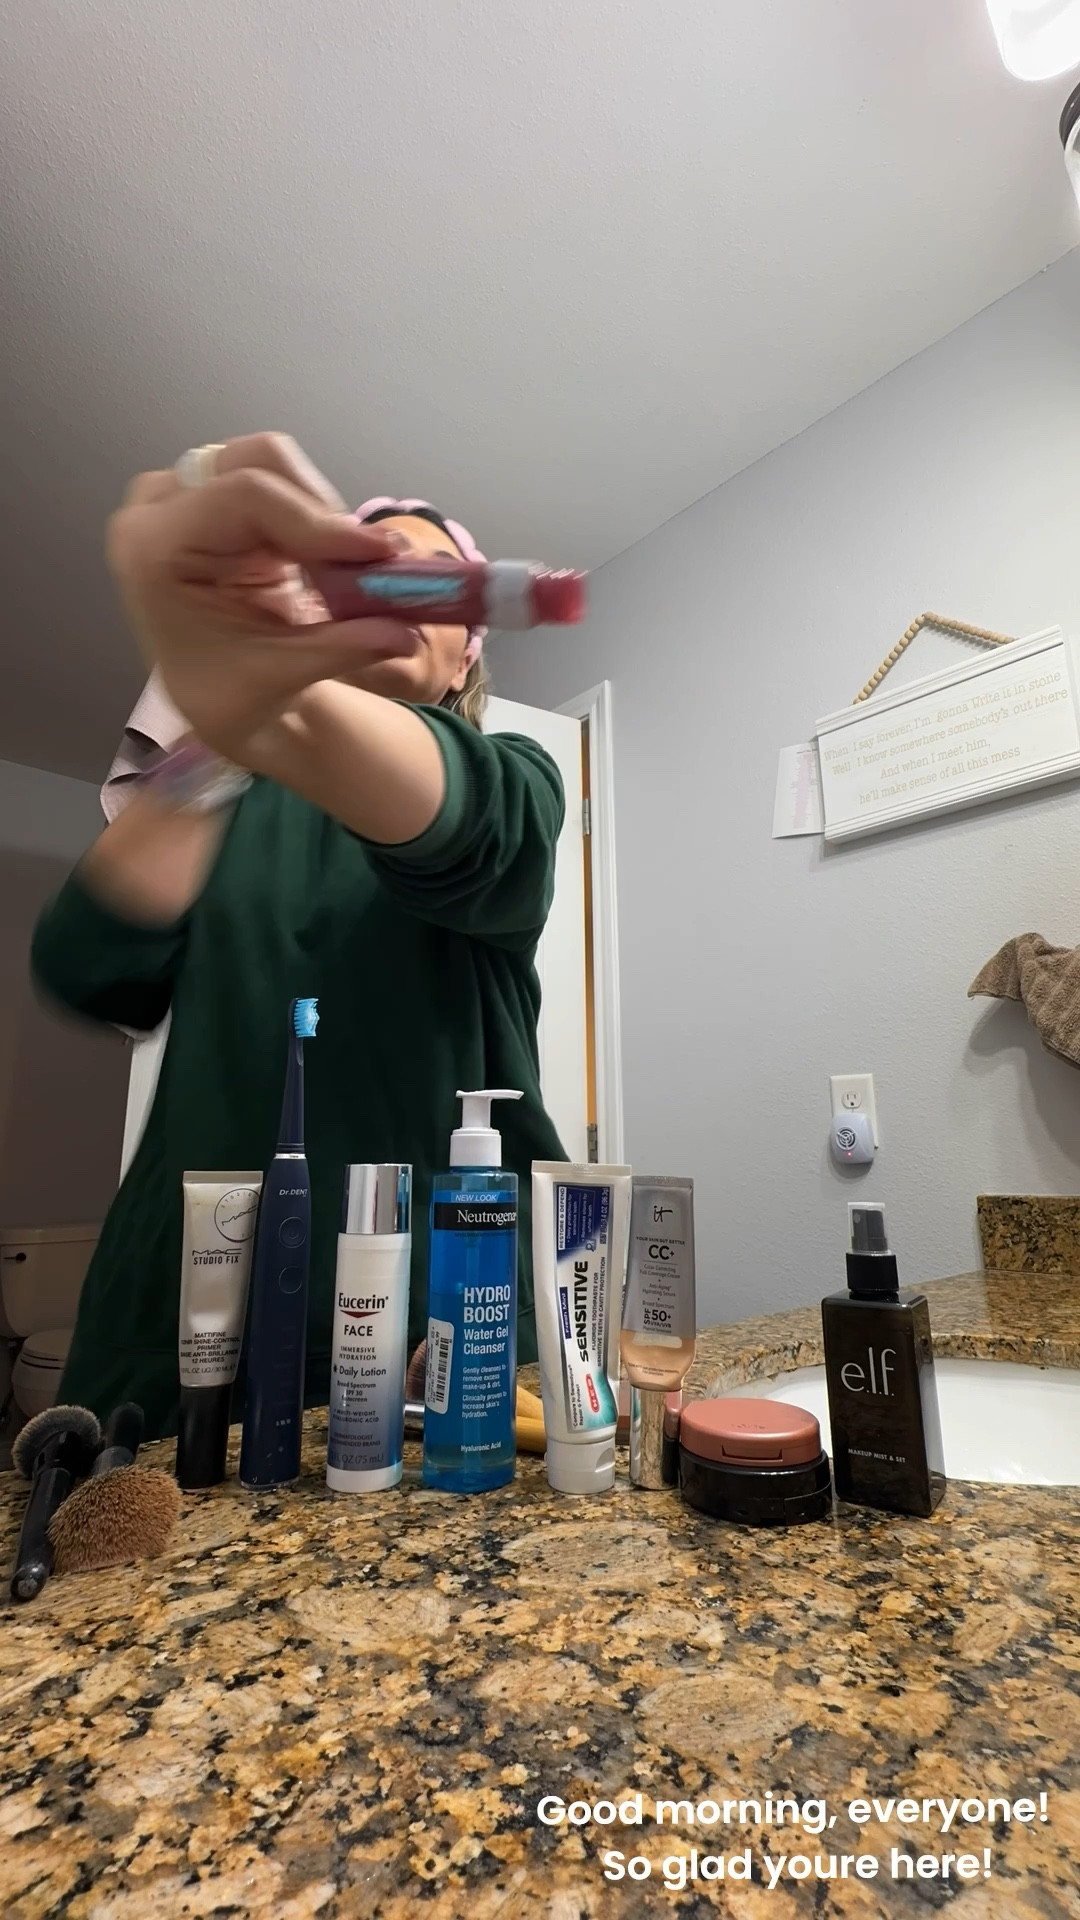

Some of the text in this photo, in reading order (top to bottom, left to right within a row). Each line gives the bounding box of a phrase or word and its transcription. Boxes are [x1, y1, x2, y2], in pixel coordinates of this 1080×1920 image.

[859, 736, 875, 750] say
[914, 715, 932, 730] I'm
[936, 703, 970, 724] gonna
[1003, 687, 1012, 700] it
[1014, 682, 1026, 696] in
[1029, 671, 1062, 691] stone
[862, 748, 887, 765] know
[889, 730, 946, 757] somewhere
[947, 707, 1010, 737] somebody's
[1013, 699, 1034, 715] out
[1035, 688, 1069, 708] there
[880, 763, 903, 779] And
[902, 754, 930, 771] when
[937, 744, 965, 762] meet
[965, 736, 991, 753] him,
[881, 781, 908, 799] make
[908, 771, 938, 790] sense
[940, 764, 952, 780] of
[952, 760, 966, 777] all
[967, 755, 990, 772] this
[990, 745, 1021, 763] mess
[456, 1193, 498, 1202] NEW LOOK
[653, 1204, 674, 1223] it
[648, 1244, 675, 1260] CC+
[193, 1255, 239, 1266] STUDIO FIX
[464, 1284, 511, 1304] HYDRO
[463, 1303, 510, 1324] BOOST
[574, 1260, 589, 1362] SENSITIVE
[643, 1307, 672, 1325] SPF 50+
[194, 1331, 227, 1339] MATTIFINE
[343, 1324, 374, 1337] FACE
[464, 1325, 509, 1341] Water Gel
[340, 1345, 376, 1354] IMMERSIVE
[464, 1341, 506, 1356] Cleanser
[339, 1352, 377, 1361] HYDRATION
[339, 1365, 387, 1379] Daily Lotion
[463, 1366, 480, 1375] Gently
[350, 1381, 377, 1389] Spectrum
[463, 1383, 487, 1391] make-up
[463, 1394, 486, 1402] Clinically
[460, 1440, 502, 1453] Hyaluronic Acid
[848, 1448, 872, 1457] MAKEUP
[873, 1452, 888, 1460] MIST
